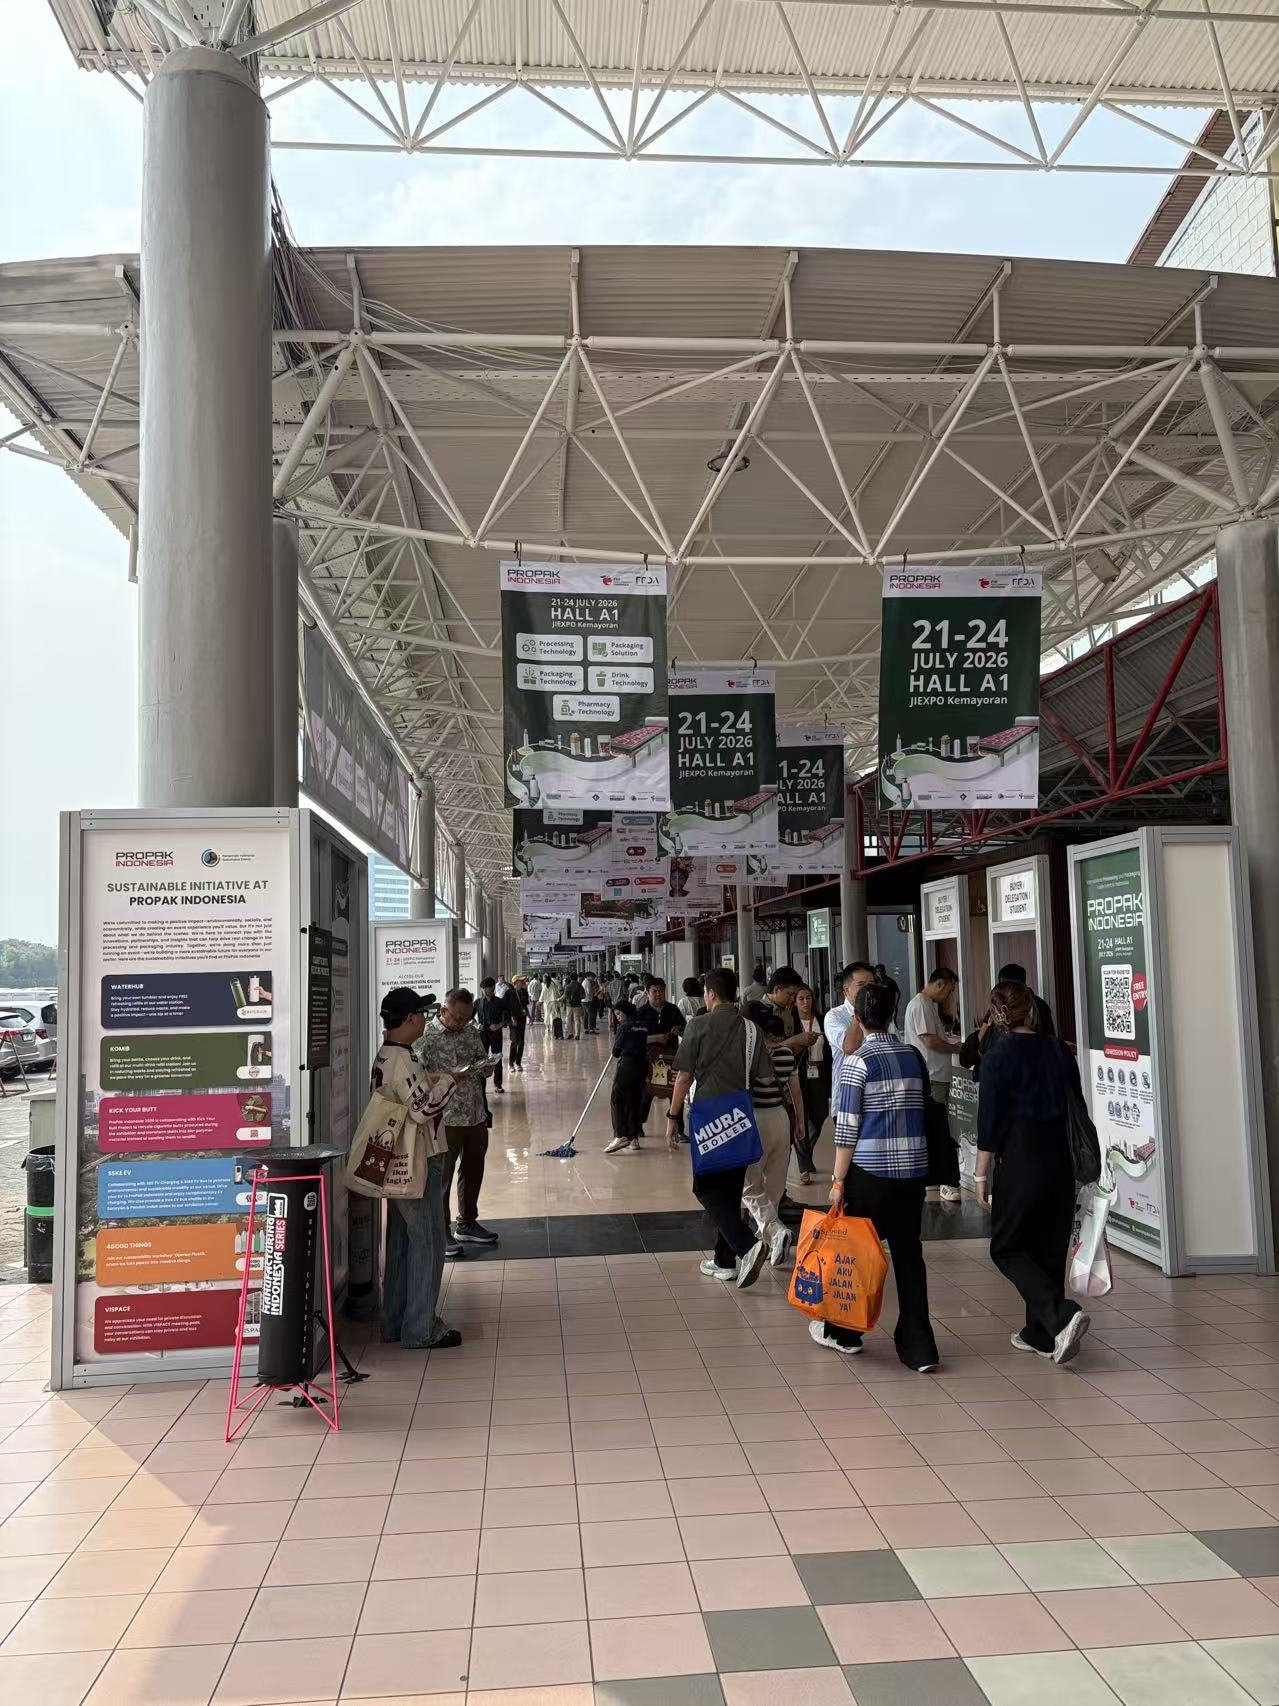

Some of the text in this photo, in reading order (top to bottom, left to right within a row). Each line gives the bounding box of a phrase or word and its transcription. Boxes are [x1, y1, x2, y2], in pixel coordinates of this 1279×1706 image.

[507, 569, 560, 578] PROPAK
[890, 574, 940, 582] PROPAK
[507, 576, 560, 585] INDONESIA
[551, 598, 575, 607] 21-24
[576, 599, 596, 608] JULY
[551, 608, 619, 621] HALL A1
[912, 619, 1008, 649] 21-24
[611, 642, 644, 650] Packaging
[910, 652, 1008, 673] JULY 2026
[540, 670, 573, 678] Packaging
[540, 678, 577, 686] Technology
[909, 674, 1008, 692] HALL A1
[909, 696, 1008, 708] JIEXPO Kemayoran
[678, 710, 753, 735] 21-24
[679, 735, 753, 752] JULY 2026
[678, 752, 754, 768] HALL A1
[679, 769, 754, 779] JIEXPO Kemayoran
[778, 759, 825, 778] 1-24
[797, 778, 825, 790] 2026
[777, 792, 826, 804] ALL A1
[116, 851, 173, 860] PROPAK
[107, 880, 268, 892] SUSTAINABLE INITIATIVE AT
[129, 894, 246, 906] PROPAK INDONESIA
[1087, 892, 1143, 916] PROPAK
[1010, 903, 1027, 914] STUDENT
[1088, 912, 1145, 931] INDONESIA
[386, 939, 436, 948] PROPAK
[1098, 938, 1113, 949] 21-24
[1133, 982, 1144, 991] FREE
[952, 1076, 979, 1093] ROPAK
[949, 1088, 979, 1103] NDONESIA
[694, 1108, 747, 1145] MIURA
[702, 1120, 749, 1152] BOILER
[262, 1216, 275, 1316] MANUFACTURING
[834, 1254, 856, 1266] AJAK
[270, 1219, 286, 1316] INDONESIA SERIES
[837, 1267, 853, 1277] AKU
[829, 1278, 852, 1289] JALAN
[832, 1290, 856, 1302] JALAN
